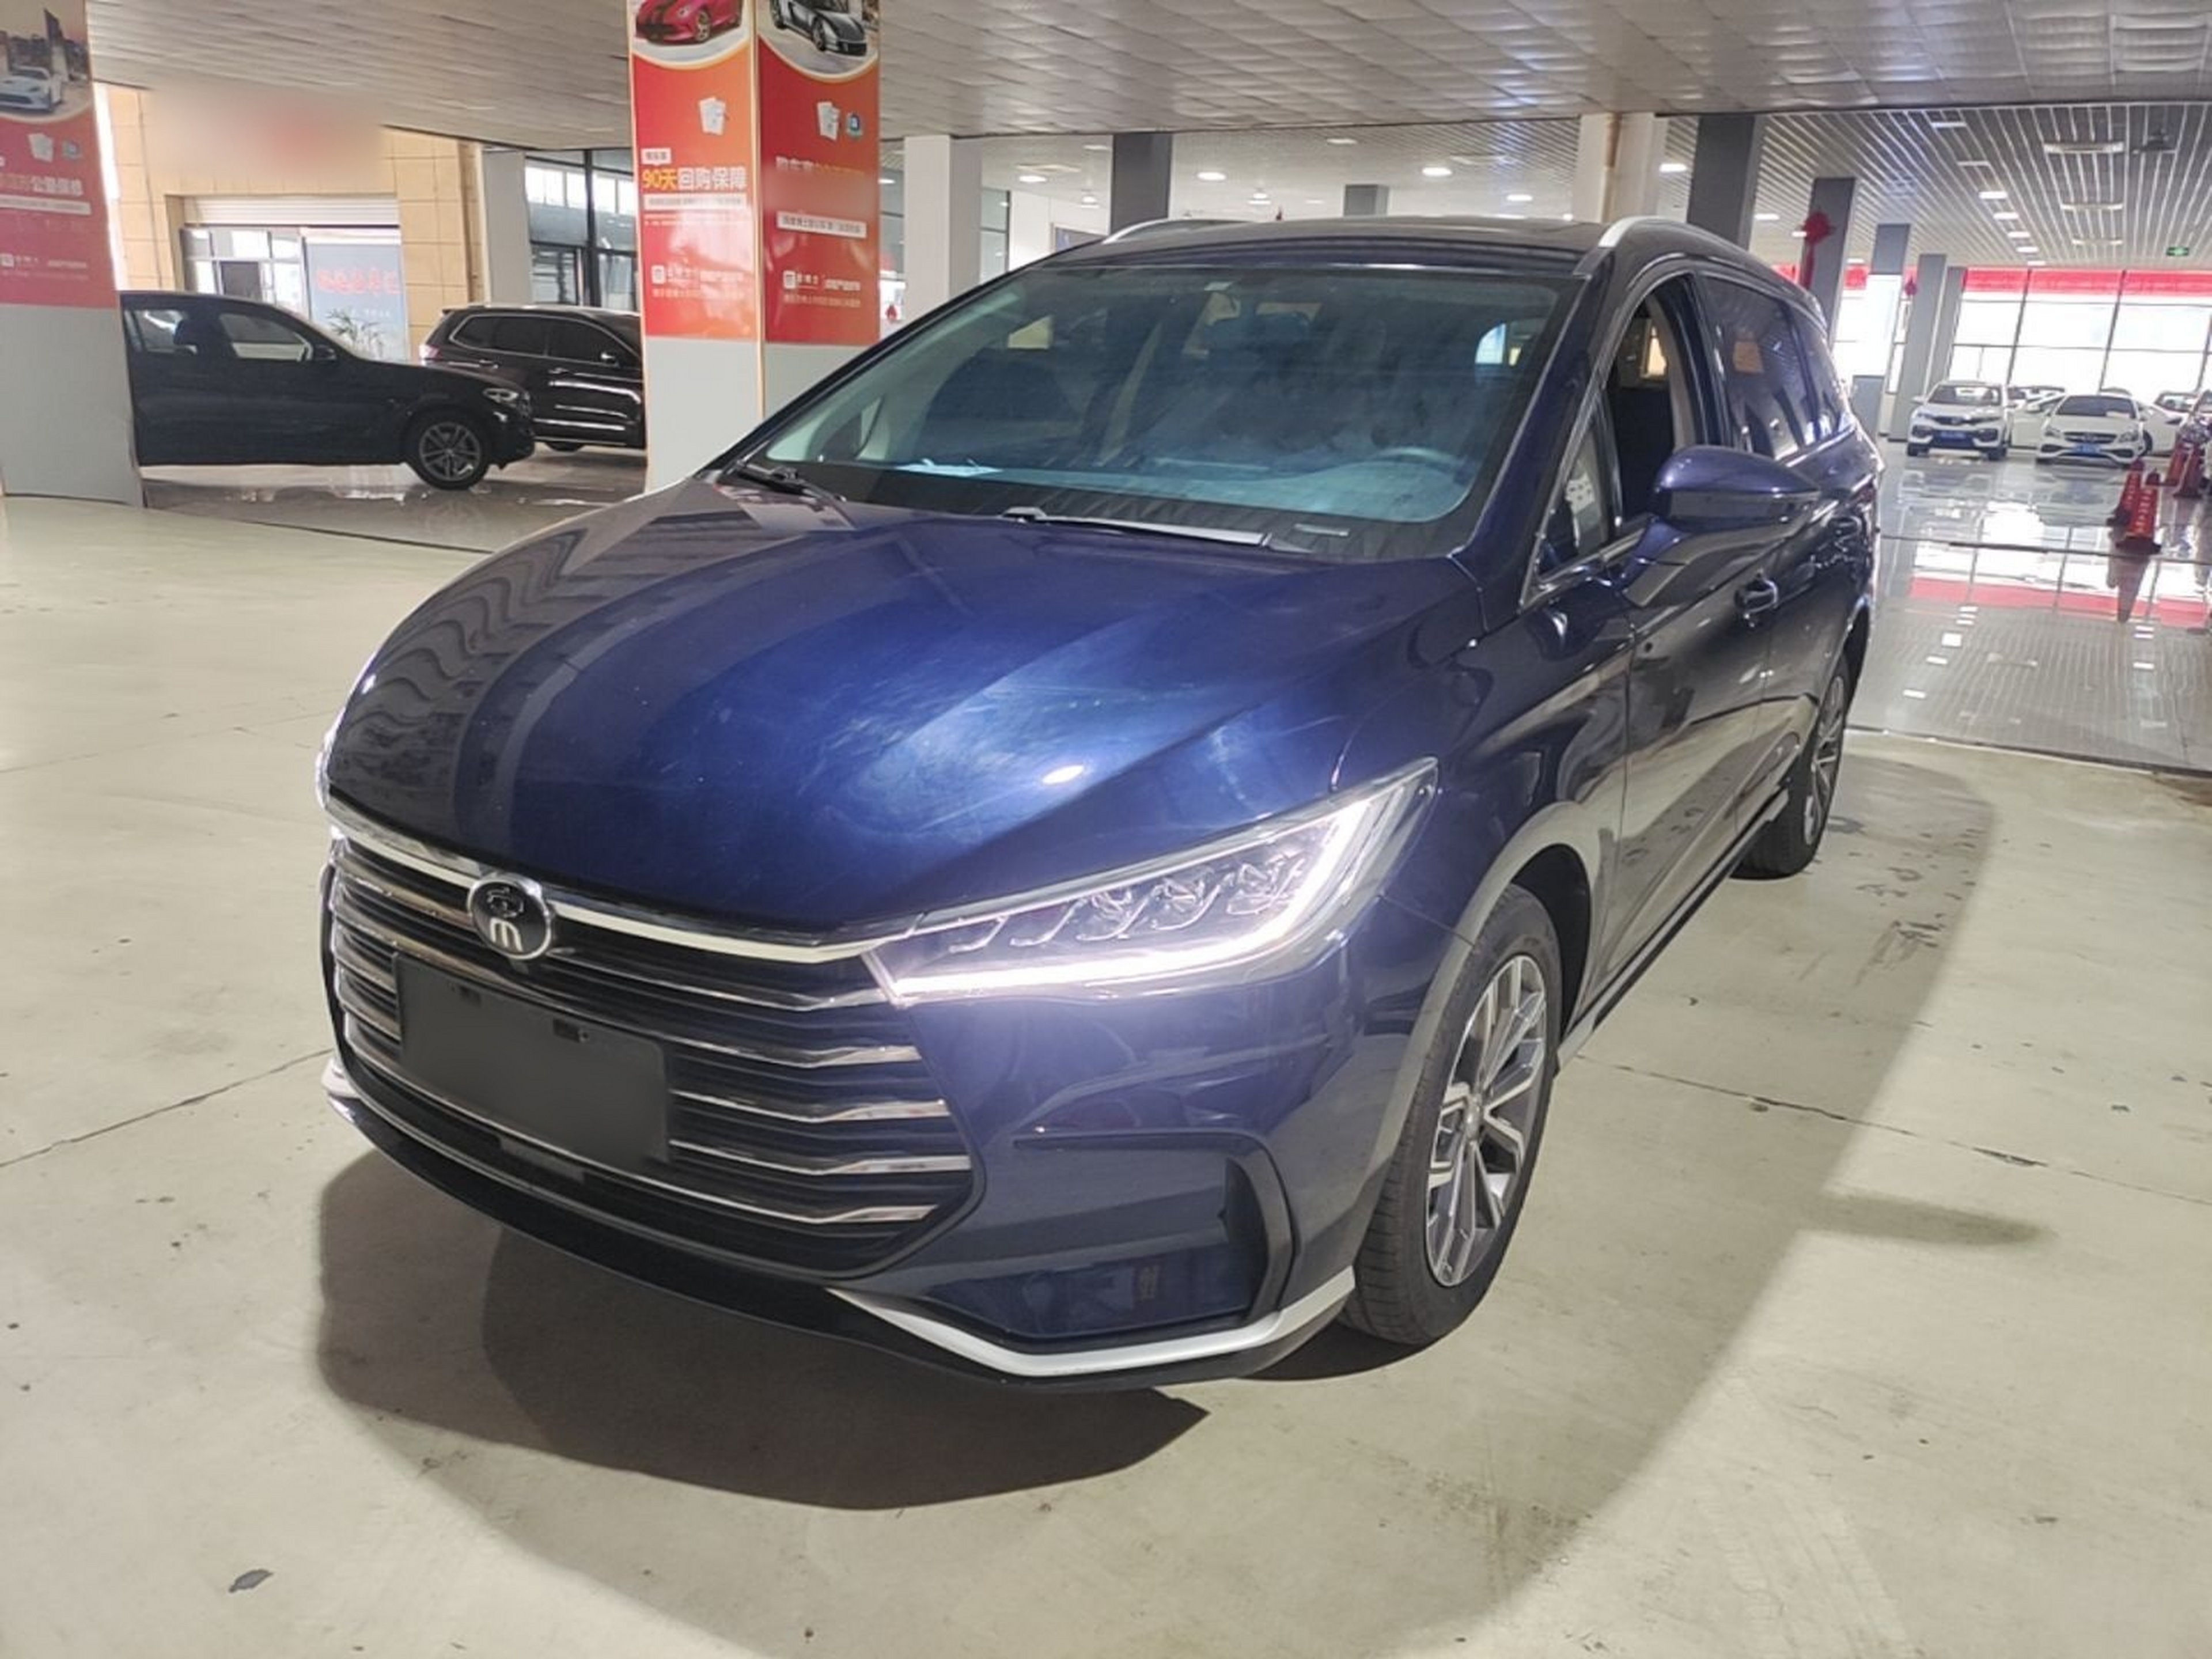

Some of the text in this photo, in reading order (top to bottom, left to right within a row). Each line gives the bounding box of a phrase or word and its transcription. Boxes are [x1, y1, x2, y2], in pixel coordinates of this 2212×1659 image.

[642, 166, 747, 191] 90天回购保障
